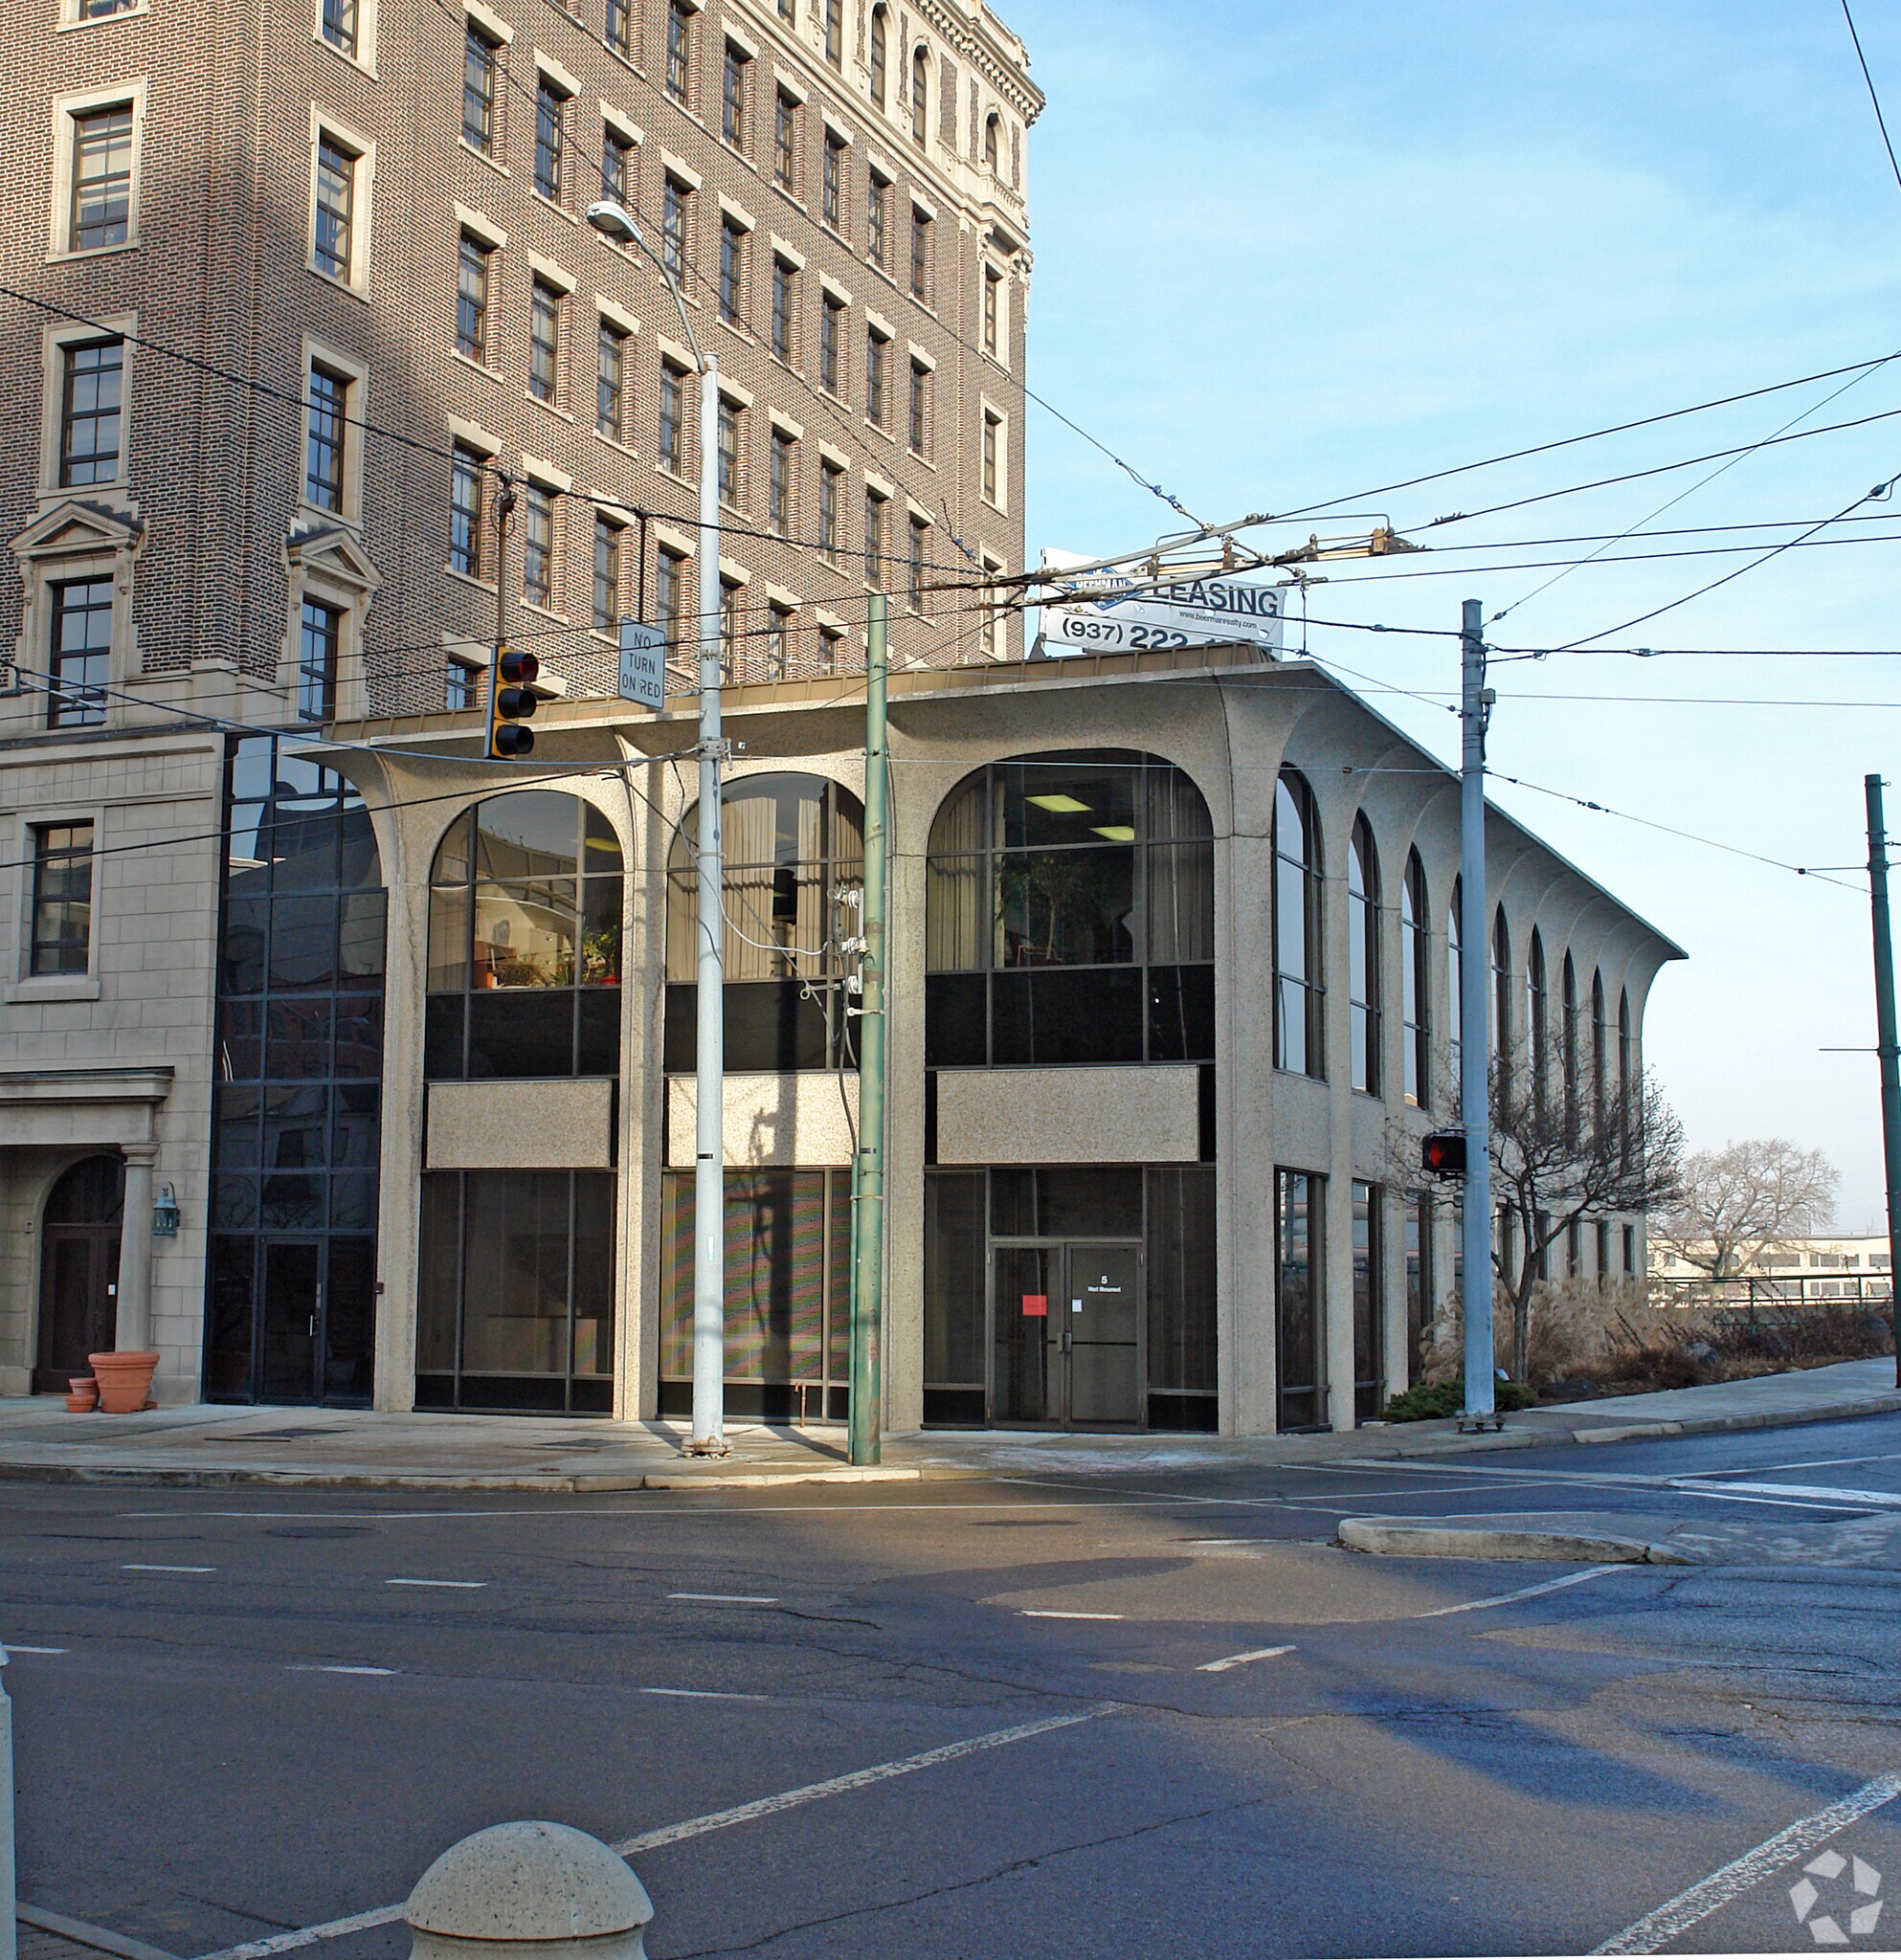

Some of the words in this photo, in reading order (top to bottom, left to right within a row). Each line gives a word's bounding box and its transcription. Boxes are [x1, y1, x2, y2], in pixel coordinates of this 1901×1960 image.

[1153, 574, 1278, 616] LEASING
[634, 632, 651, 650] NO
[1062, 617, 1124, 644] (937)
[629, 653, 656, 675] TURN
[622, 674, 637, 691] ON
[639, 679, 660, 699] RED
[1101, 1275, 1108, 1284] 5
